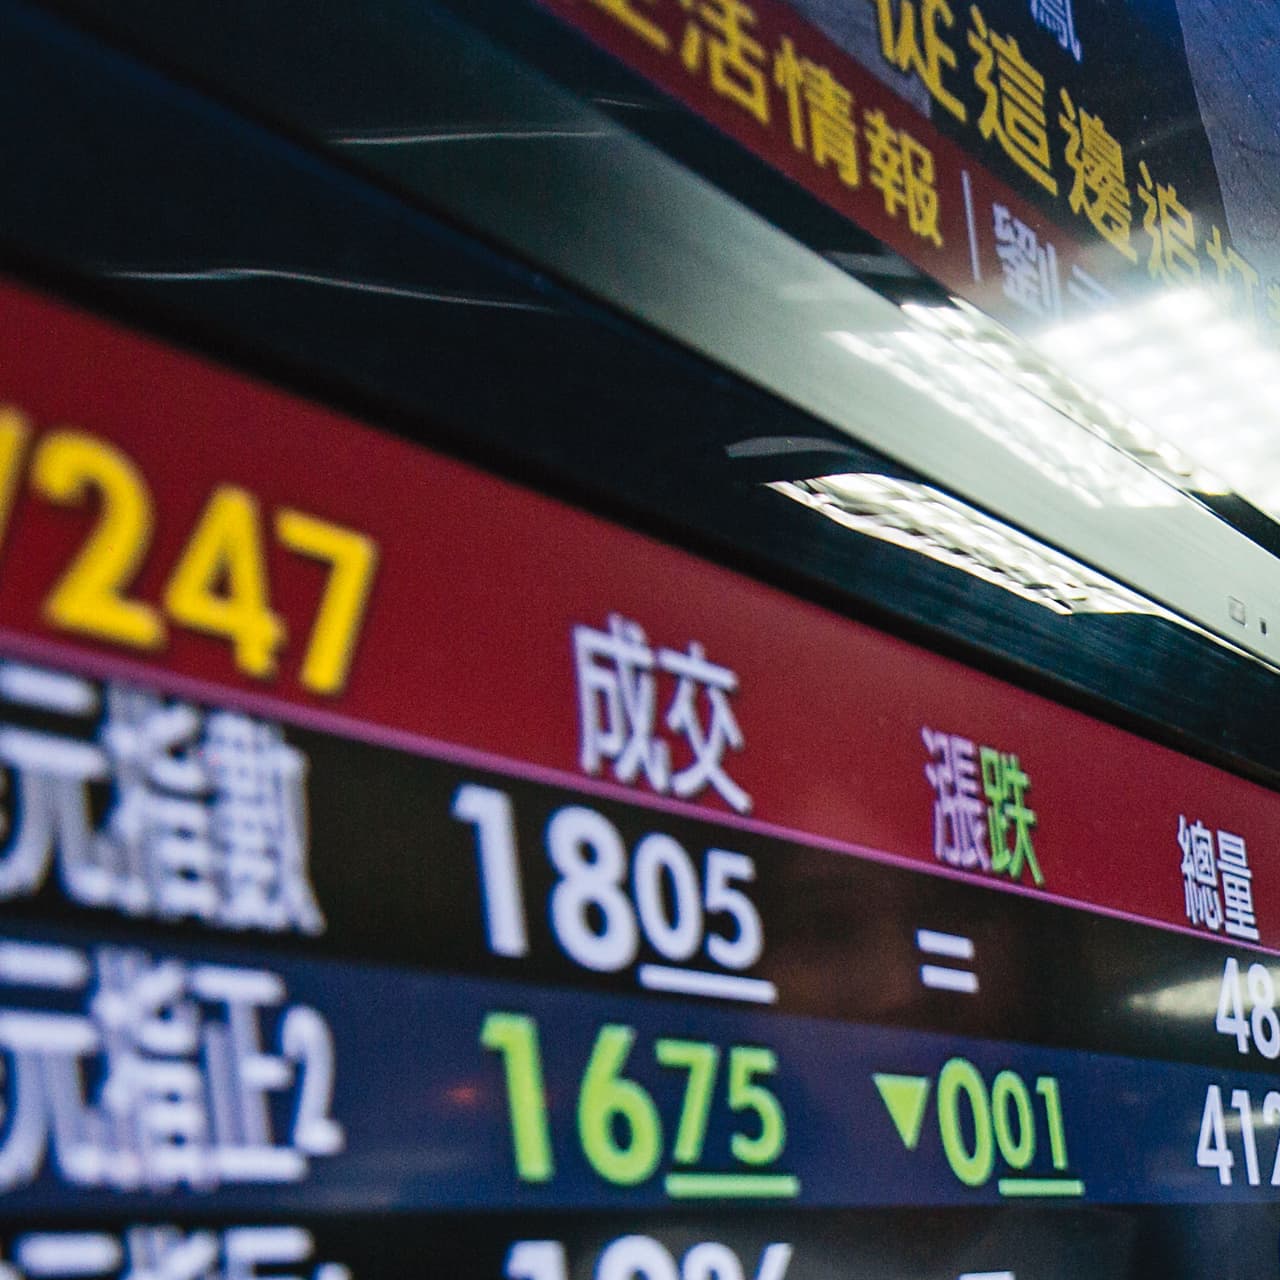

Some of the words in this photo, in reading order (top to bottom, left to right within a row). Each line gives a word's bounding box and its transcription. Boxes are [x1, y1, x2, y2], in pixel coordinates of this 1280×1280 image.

[605, 0, 944, 248] 活情報
[452, 782, 766, 974] 1805
[572, 612, 752, 814] 成交
[922, 725, 1044, 888] 漲跌
[1179, 814, 1260, 941] 總量
[480, 1011, 787, 1186] 1675
[937, 1057, 1068, 1187] 001
